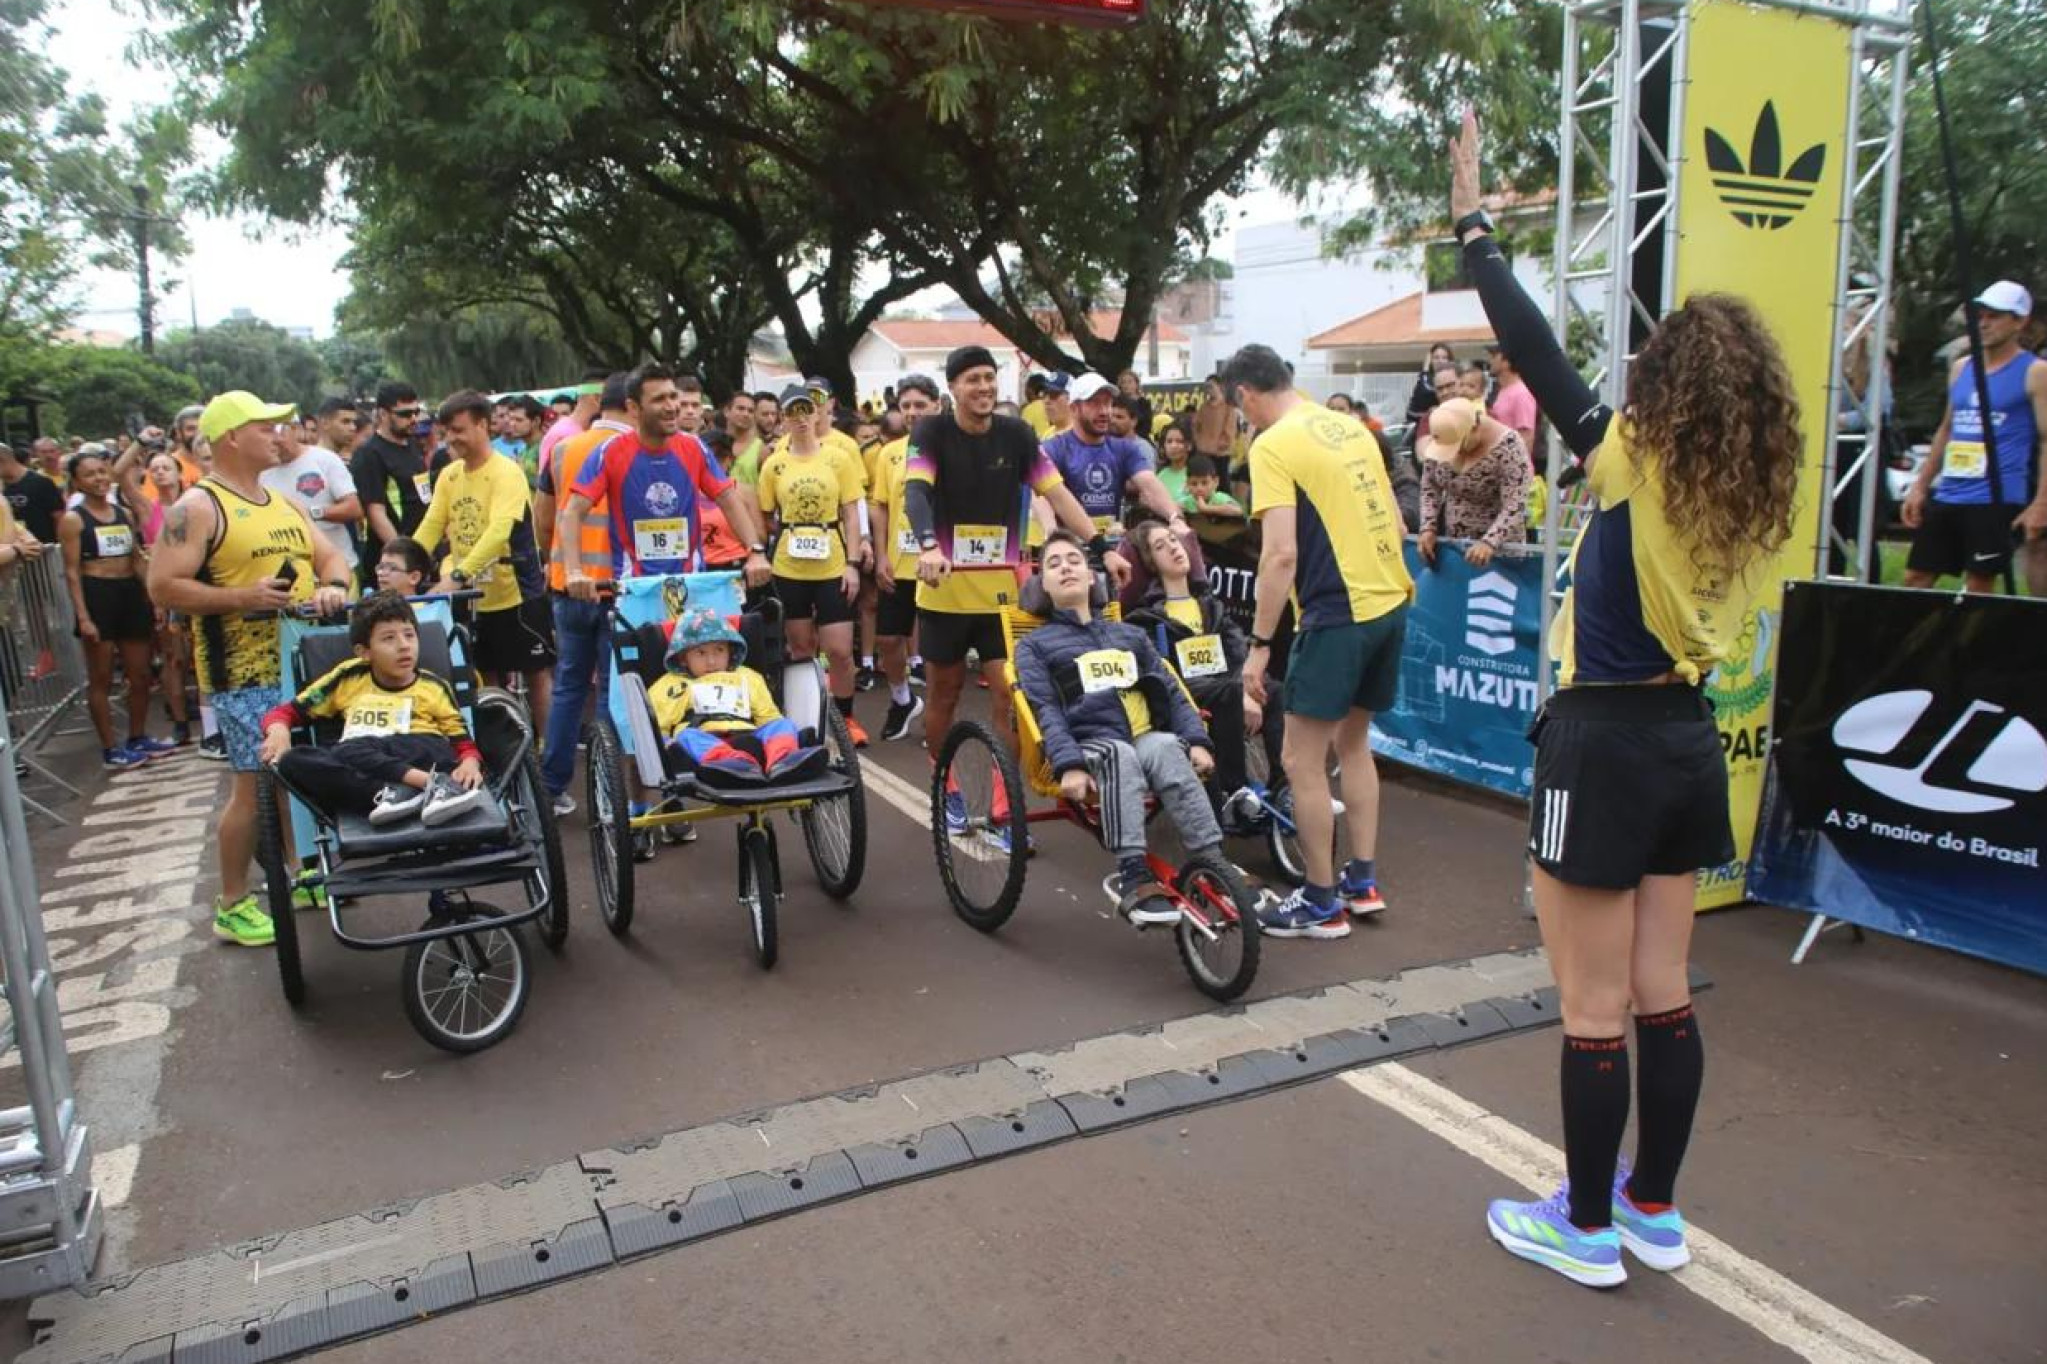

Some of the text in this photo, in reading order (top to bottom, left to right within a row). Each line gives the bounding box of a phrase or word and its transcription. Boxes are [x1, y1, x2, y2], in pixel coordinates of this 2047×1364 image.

[652, 533, 667, 548] 16
[796, 538, 818, 550] 202
[969, 539, 985, 554] 14
[1188, 650, 1212, 665] 502
[1090, 662, 1124, 678] 504
[1458, 655, 1530, 676] CONSTRUTORA
[713, 685, 723, 700] 7
[351, 709, 389, 727] 505
[1825, 808, 1841, 826] A
[1871, 824, 1933, 846] maior
[1936, 831, 1965, 851] do
[1970, 837, 2039, 867] Brasil
